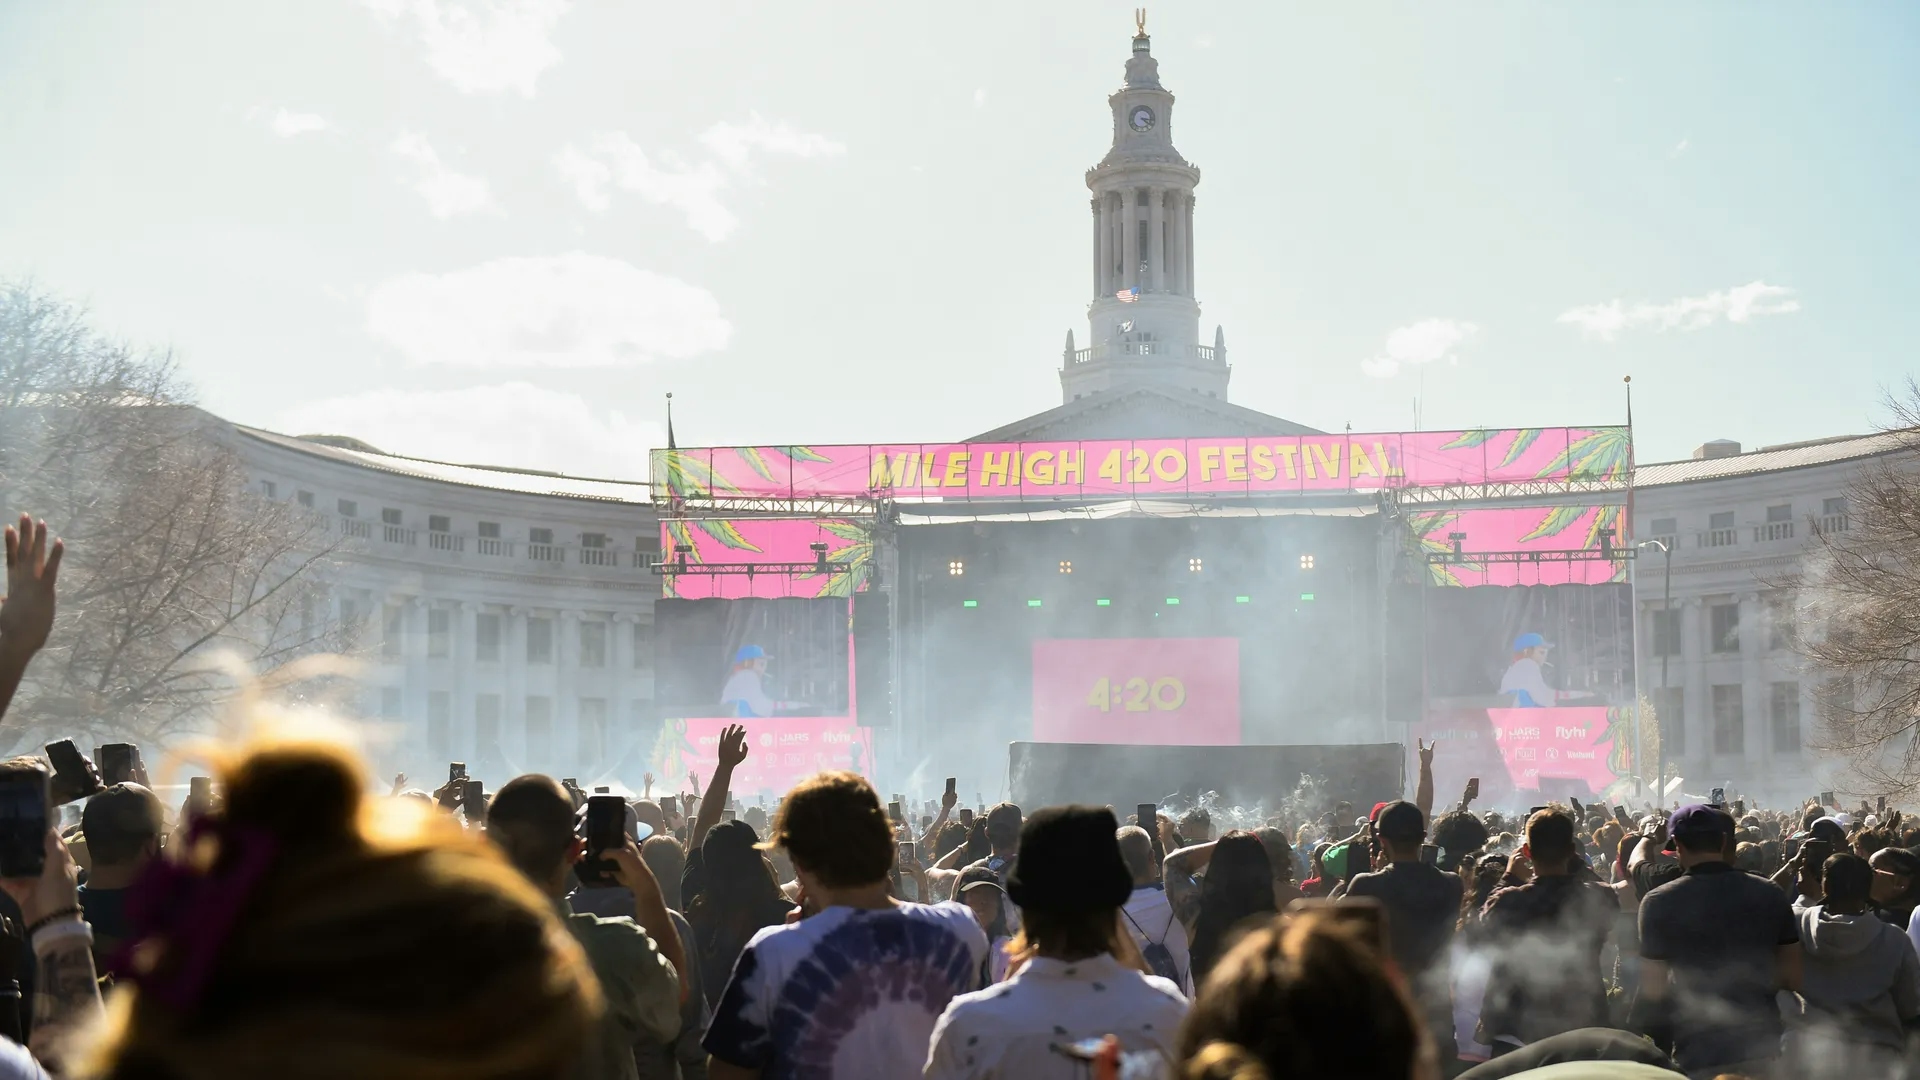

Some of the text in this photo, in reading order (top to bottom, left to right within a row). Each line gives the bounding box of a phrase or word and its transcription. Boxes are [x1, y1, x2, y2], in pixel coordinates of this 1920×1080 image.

[869, 442, 1405, 488] MILE HIGH 420 FESTIVAL
[1087, 676, 1187, 713] 4:20
[779, 733, 809, 742] JARS
[1508, 727, 1540, 736] JARS
